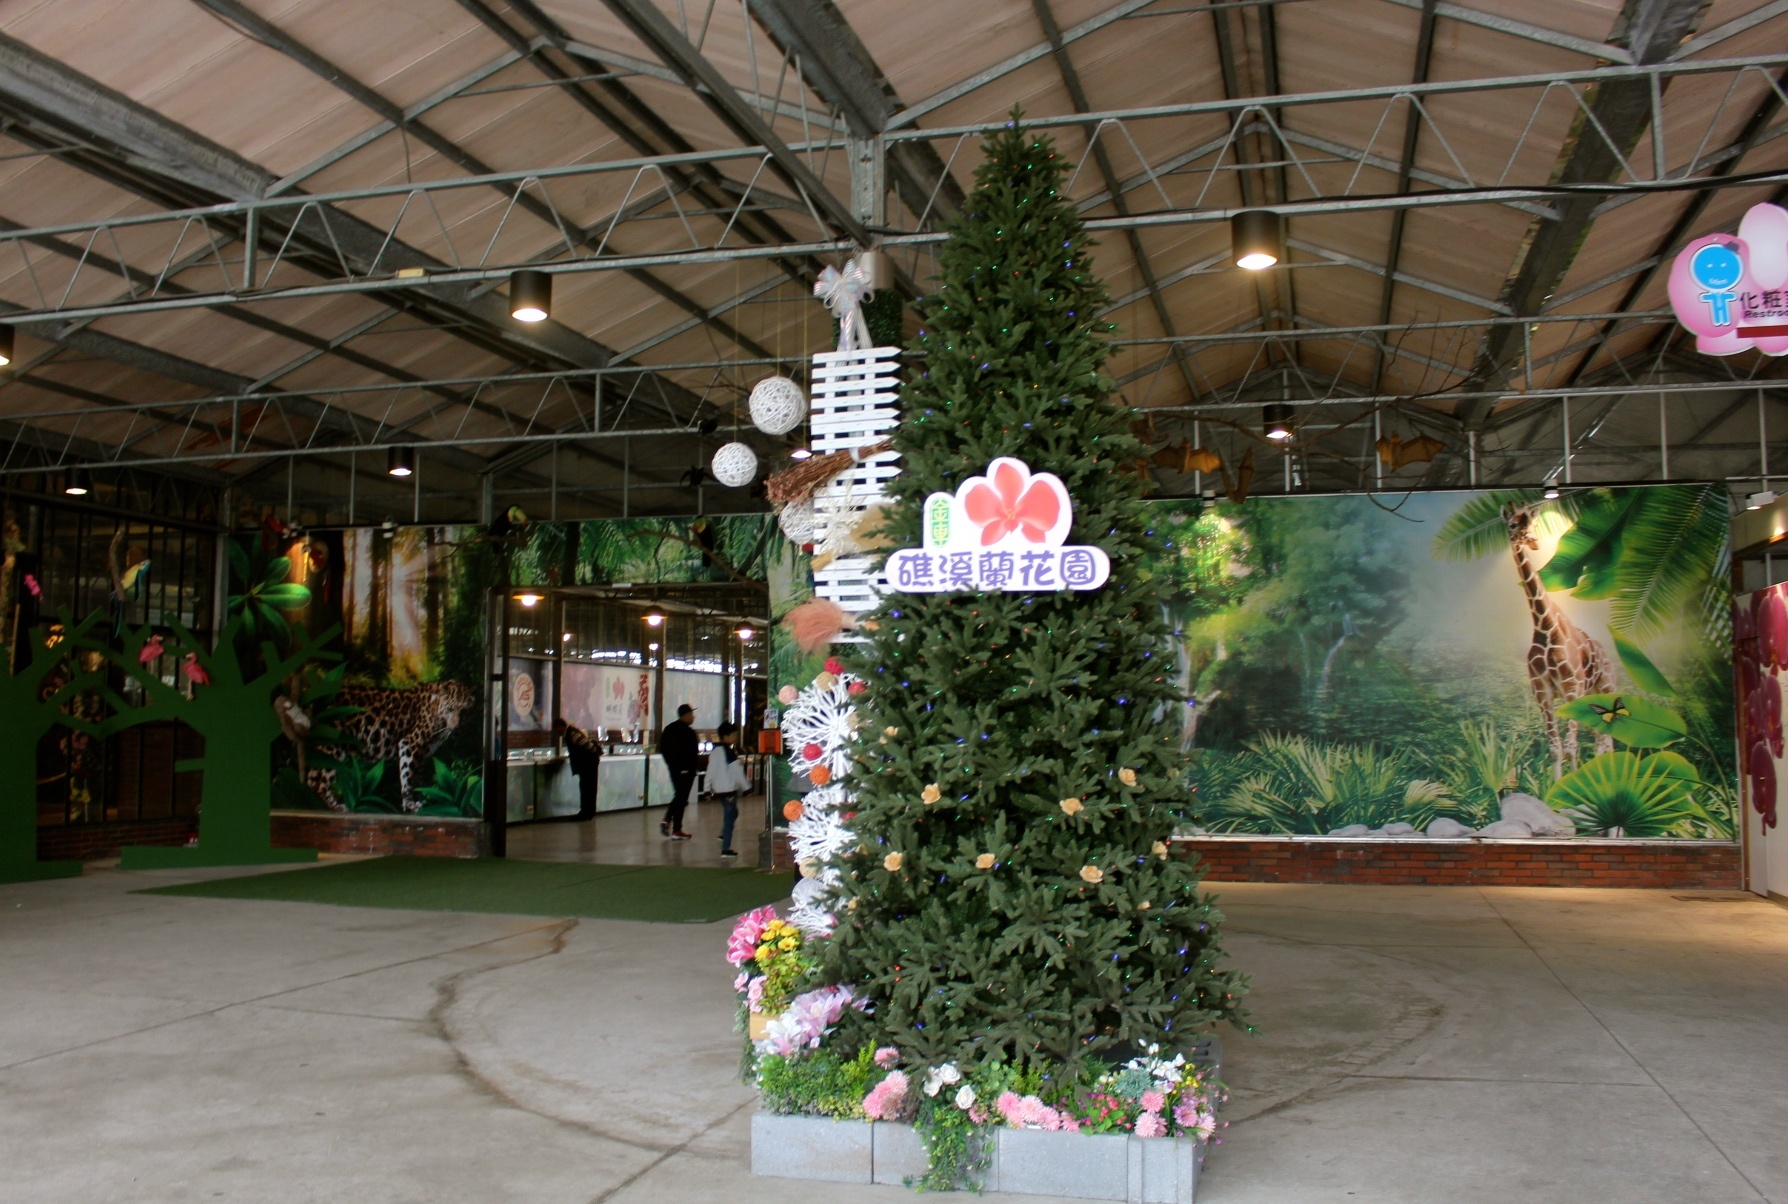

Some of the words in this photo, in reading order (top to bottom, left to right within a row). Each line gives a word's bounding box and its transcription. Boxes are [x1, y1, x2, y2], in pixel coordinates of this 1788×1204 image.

[1740, 289, 1788, 310] 化粧
[898, 550, 1096, 587] 礁溪蘭花園
